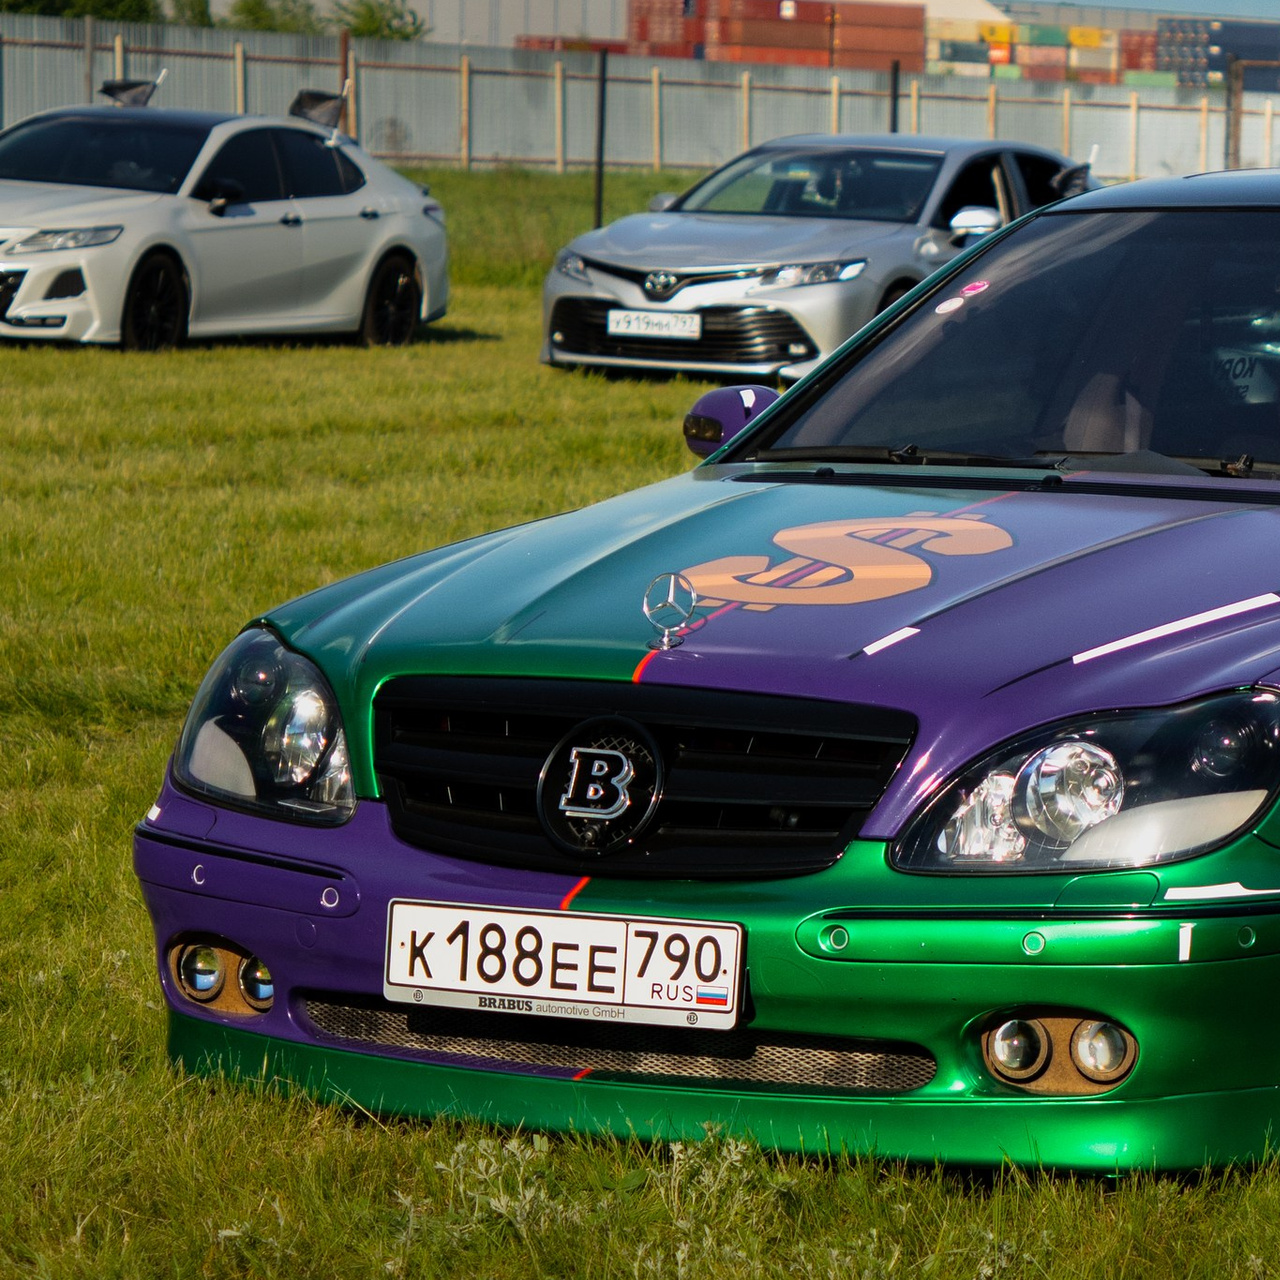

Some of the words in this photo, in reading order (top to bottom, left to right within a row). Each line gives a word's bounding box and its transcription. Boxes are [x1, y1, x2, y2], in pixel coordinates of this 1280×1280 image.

[559, 747, 635, 819] B
[633, 929, 722, 983] 790
[478, 996, 533, 1012] BRABUS
[535, 1002, 590, 1017] automotive
[592, 1006, 626, 1020] GmbH
[650, 983, 694, 1003] RUS
